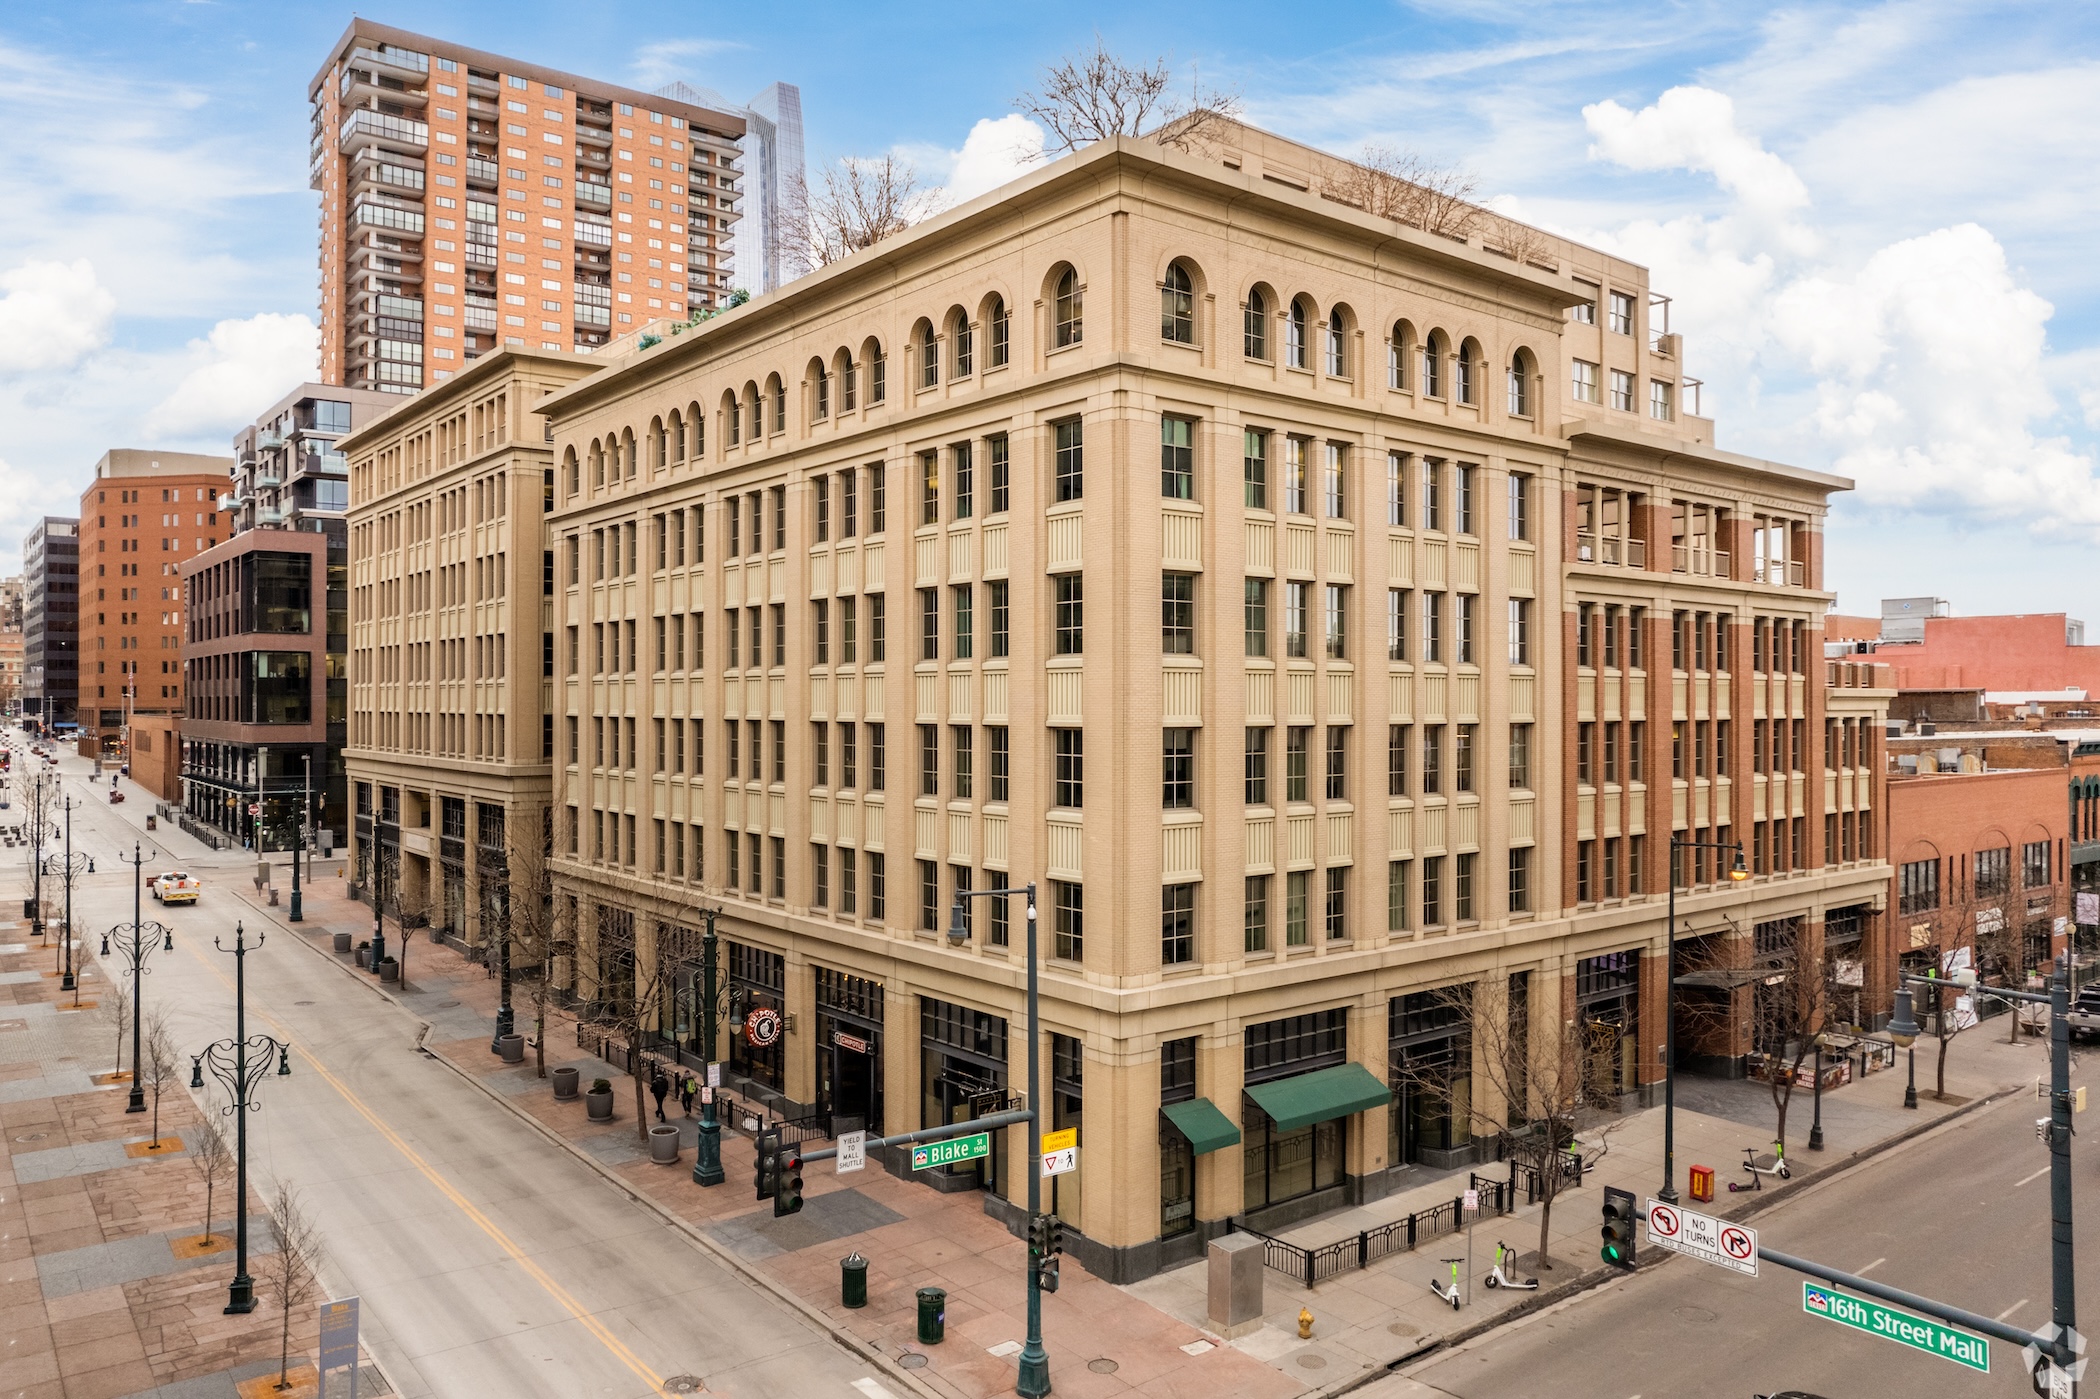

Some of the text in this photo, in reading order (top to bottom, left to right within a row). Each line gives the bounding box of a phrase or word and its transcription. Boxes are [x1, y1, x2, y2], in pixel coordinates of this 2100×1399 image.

[749, 1009, 781, 1028] CHIPOTLE
[841, 1035, 864, 1051] CHIPOTLE
[843, 1136, 860, 1145] YIELD
[1050, 1133, 1069, 1142] TURNING
[848, 1144, 856, 1152] TO
[931, 1142, 969, 1163] Blake
[977, 1138, 983, 1146] St
[973, 1144, 987, 1154] 1500
[1048, 1140, 1070, 1150] VEHICLES
[843, 1152, 859, 1160] MALL
[839, 1158, 863, 1169] SHUTTLE
[1692, 1218, 1706, 1231] NO
[1685, 1229, 1715, 1248] TURNS
[1660, 1238, 1741, 1269] RTD BUSES EXCEPTED
[1828, 1296, 1984, 1366] 16th Street Mall
[2053, 1375, 2068, 1394] BUS
